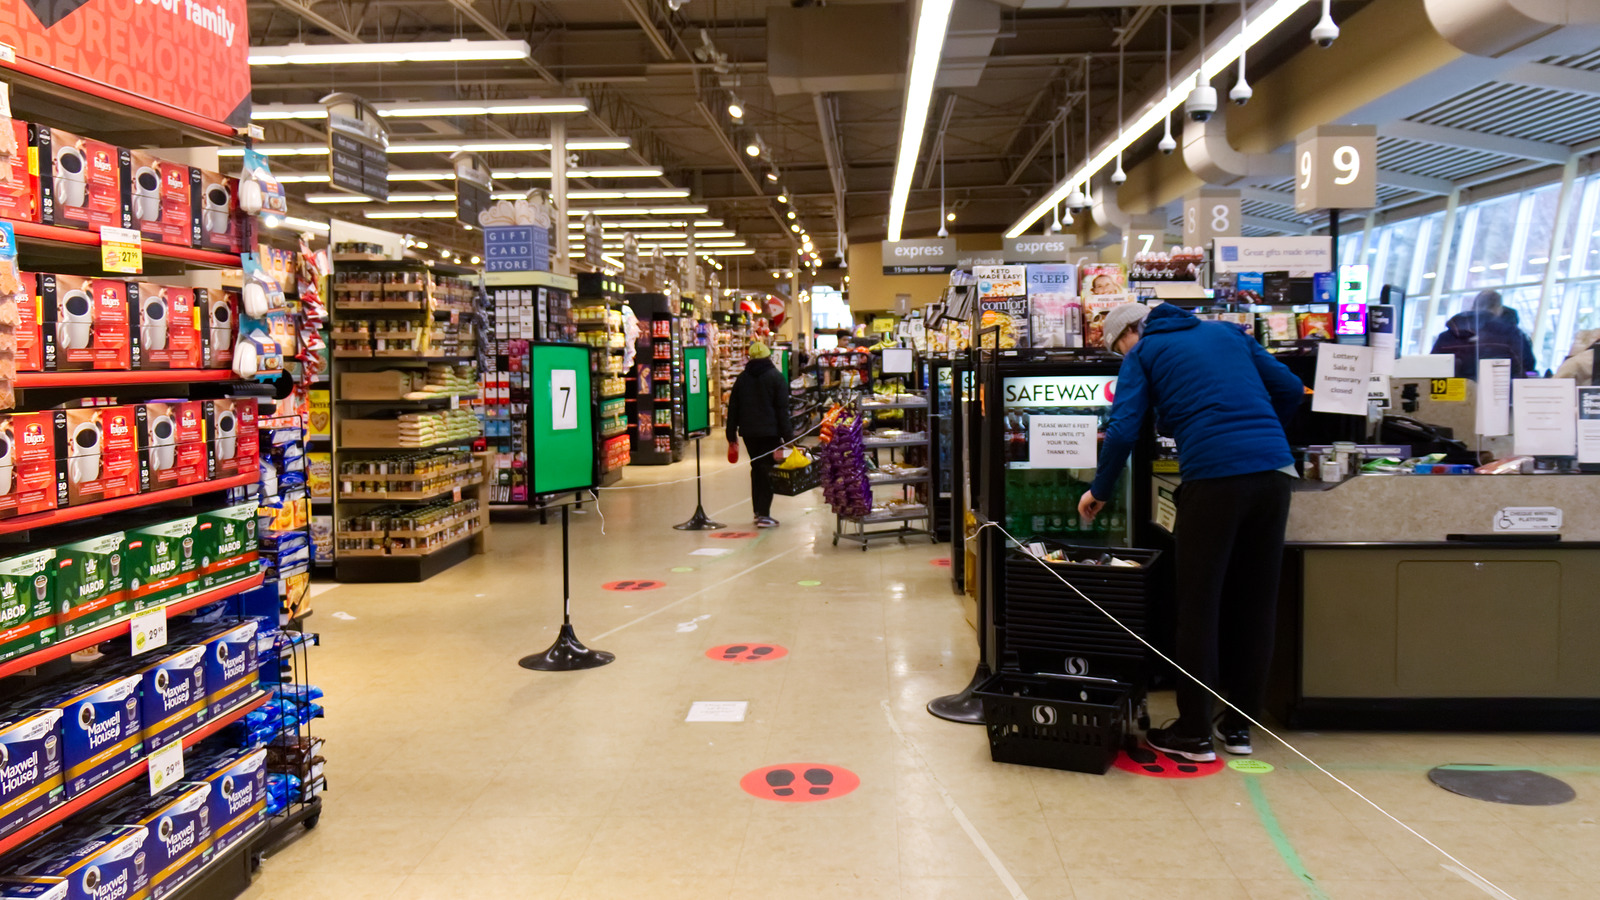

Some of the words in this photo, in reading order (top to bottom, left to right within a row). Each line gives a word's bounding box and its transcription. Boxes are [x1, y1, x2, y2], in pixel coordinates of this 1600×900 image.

[185, 0, 235, 47] family
[1300, 151, 1312, 190] 9
[1333, 146, 1360, 185] 9
[44, 198, 52, 207] 50
[1188, 207, 1196, 233] 8
[1211, 204, 1229, 231] 8
[489, 231, 526, 241] GIFT
[489, 246, 528, 255] CARD
[894, 245, 944, 259] express
[1015, 241, 1065, 254] express
[1138, 234, 1154, 256] 7
[122, 251, 131, 262] 27
[490, 260, 528, 270] STORE
[957, 257, 972, 266] self
[974, 257, 996, 265] check
[1032, 274, 1070, 284] SLEEP
[981, 297, 1027, 310] comfort
[46, 345, 55, 354] 50
[1333, 352, 1358, 361] Lottery
[692, 369, 699, 388] 5
[1431, 379, 1446, 394] 19
[1005, 384, 1099, 402] SAFEWAY
[1330, 387, 1353, 395] closed
[559, 386, 571, 419] 7
[24, 432, 46, 446] Folgers
[58, 482, 67, 490] 50
[218, 540, 241, 554] NABOB
[34, 556, 46, 573] 55
[150, 560, 176, 576] NABOB
[79, 578, 105, 597] NABOB
[0, 604, 26, 623] ABOB
[148, 628, 158, 640] 29
[223, 650, 246, 672] Maxwell
[224, 666, 242, 681] House
[162, 678, 190, 700] Maxwell
[164, 695, 186, 712] House
[88, 710, 120, 738] Maxwell
[90, 730, 116, 750] House
[0, 750, 38, 782] Maxwell
[166, 763, 174, 776] 29
[2, 770, 33, 796] House
[228, 781, 253, 805] Maxwell
[229, 797, 250, 814] House
[166, 820, 195, 848] Maxwell
[168, 837, 191, 859] House
[93, 868, 128, 900] Maxwell
